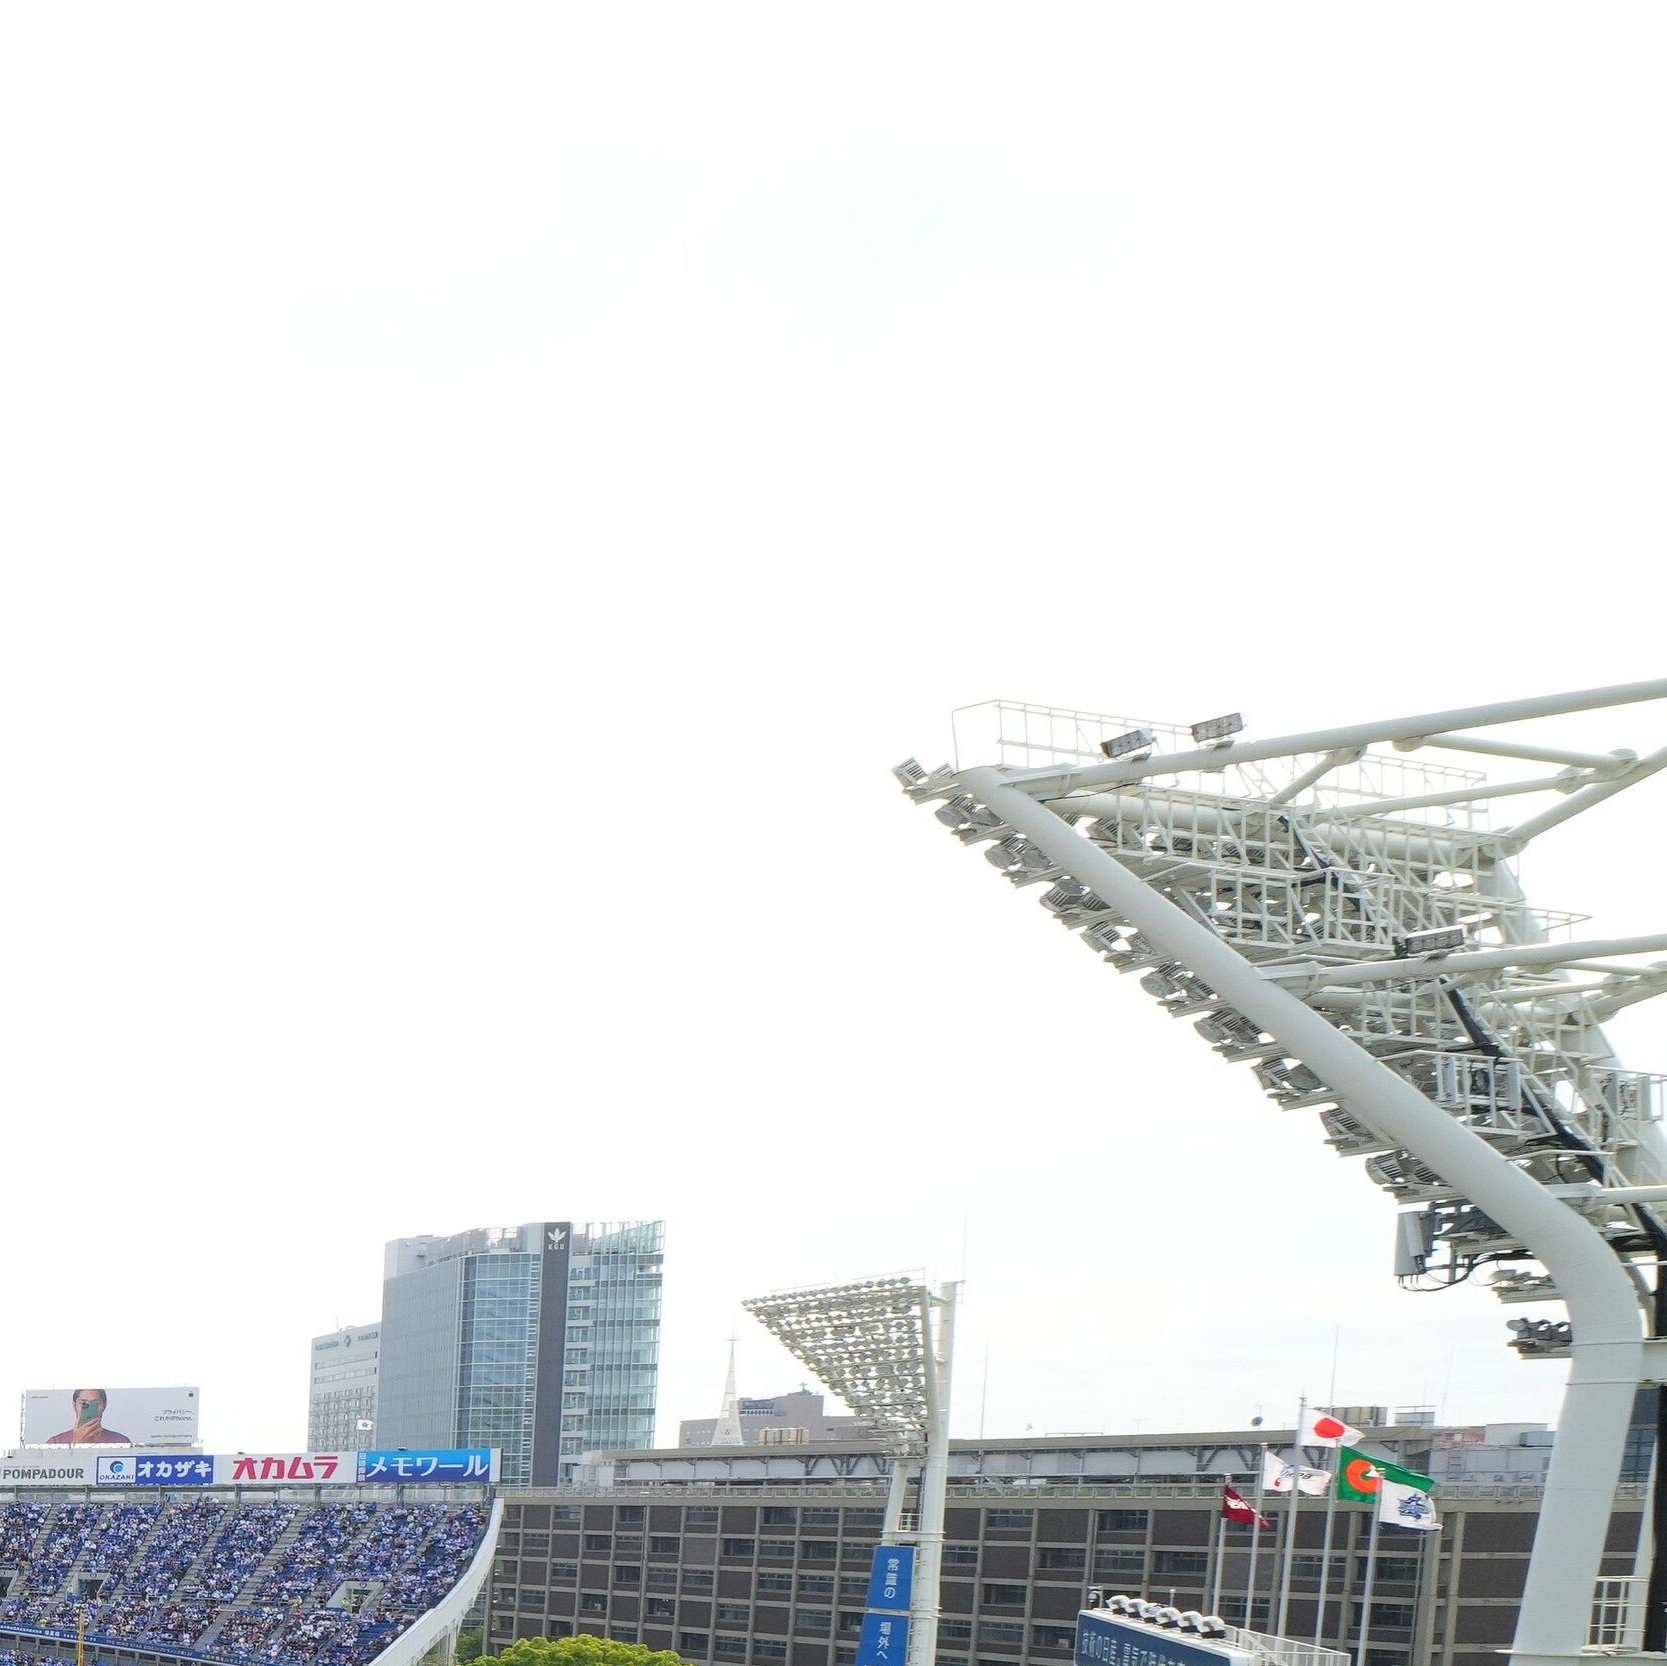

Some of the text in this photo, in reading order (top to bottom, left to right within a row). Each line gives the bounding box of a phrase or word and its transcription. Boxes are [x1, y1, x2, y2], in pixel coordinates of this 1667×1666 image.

[3, 1468, 85, 1480] POMPADOUR
[137, 1461, 213, 1479] オカザキ
[232, 1456, 339, 1480] オカムラ
[368, 1453, 490, 1478] メモワール
[99, 1473, 135, 1481] OKAZAKI
